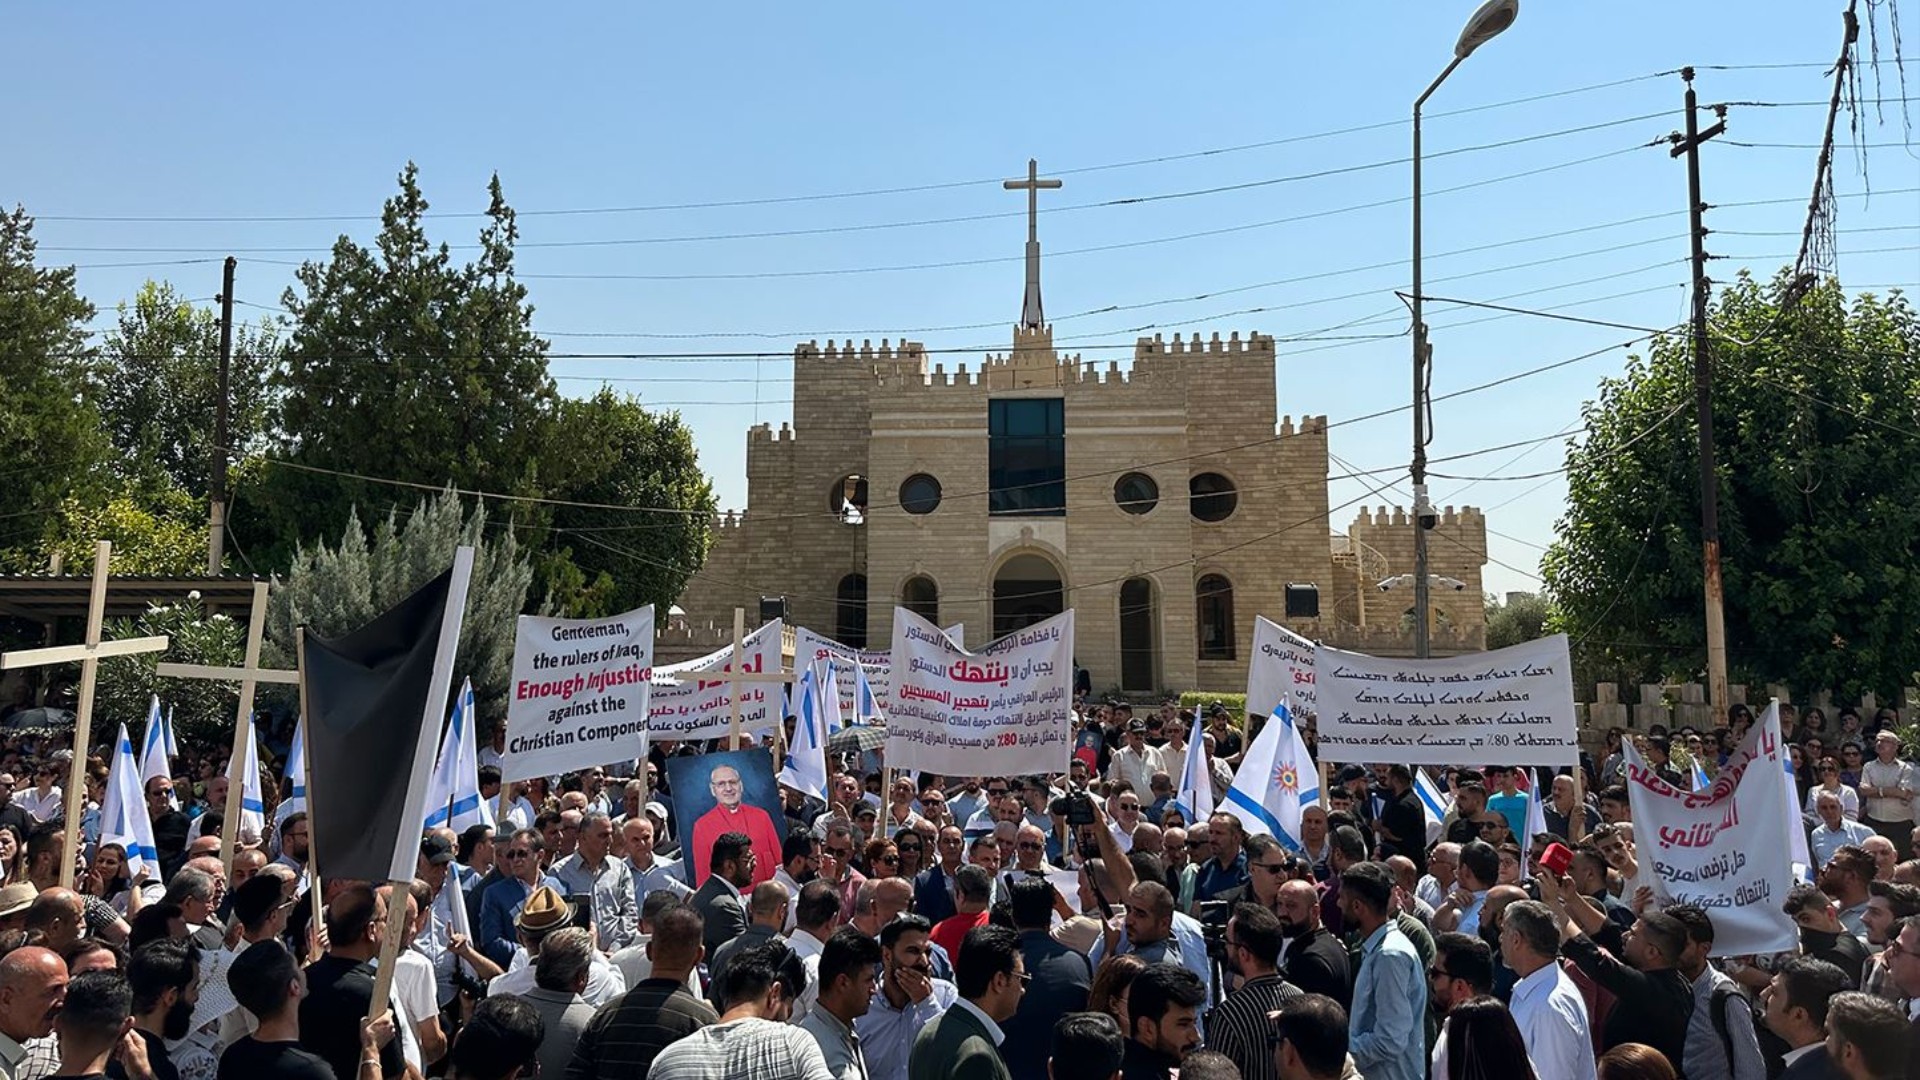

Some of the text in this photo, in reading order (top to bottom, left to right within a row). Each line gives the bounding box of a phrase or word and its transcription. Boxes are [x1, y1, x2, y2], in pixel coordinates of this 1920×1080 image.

[905, 625, 943, 647] الدستور
[1020, 631, 1050, 647] فخامة
[1050, 626, 1060, 642] يا
[533, 643, 644, 670] the rulers of Iraq,
[909, 656, 947, 679] الدستور
[948, 660, 1009, 687] ينتهك
[1033, 661, 1054, 677] يجب
[517, 664, 652, 700] Enough Injustice
[754, 688, 765, 703] يا
[899, 683, 951, 705] المسيحيين
[1038, 687, 1064, 704] الرئيس
[548, 696, 626, 725] against the
[678, 703, 689, 716] يا
[952, 695, 990, 712] بتهجير
[674, 716, 718, 734] السكوت
[920, 709, 947, 725] الكنيسة
[972, 717, 992, 730] حرمة
[1024, 709, 1051, 727] الطريق
[510, 730, 574, 753] Christian
[982, 738, 996, 750] من
[1018, 735, 1039, 748] قرابة
[1041, 730, 1059, 746] تمثل
[1699, 854, 1729, 881] ترضى
[1731, 850, 1746, 876] هل
[1734, 878, 1771, 907] بانتهاك
